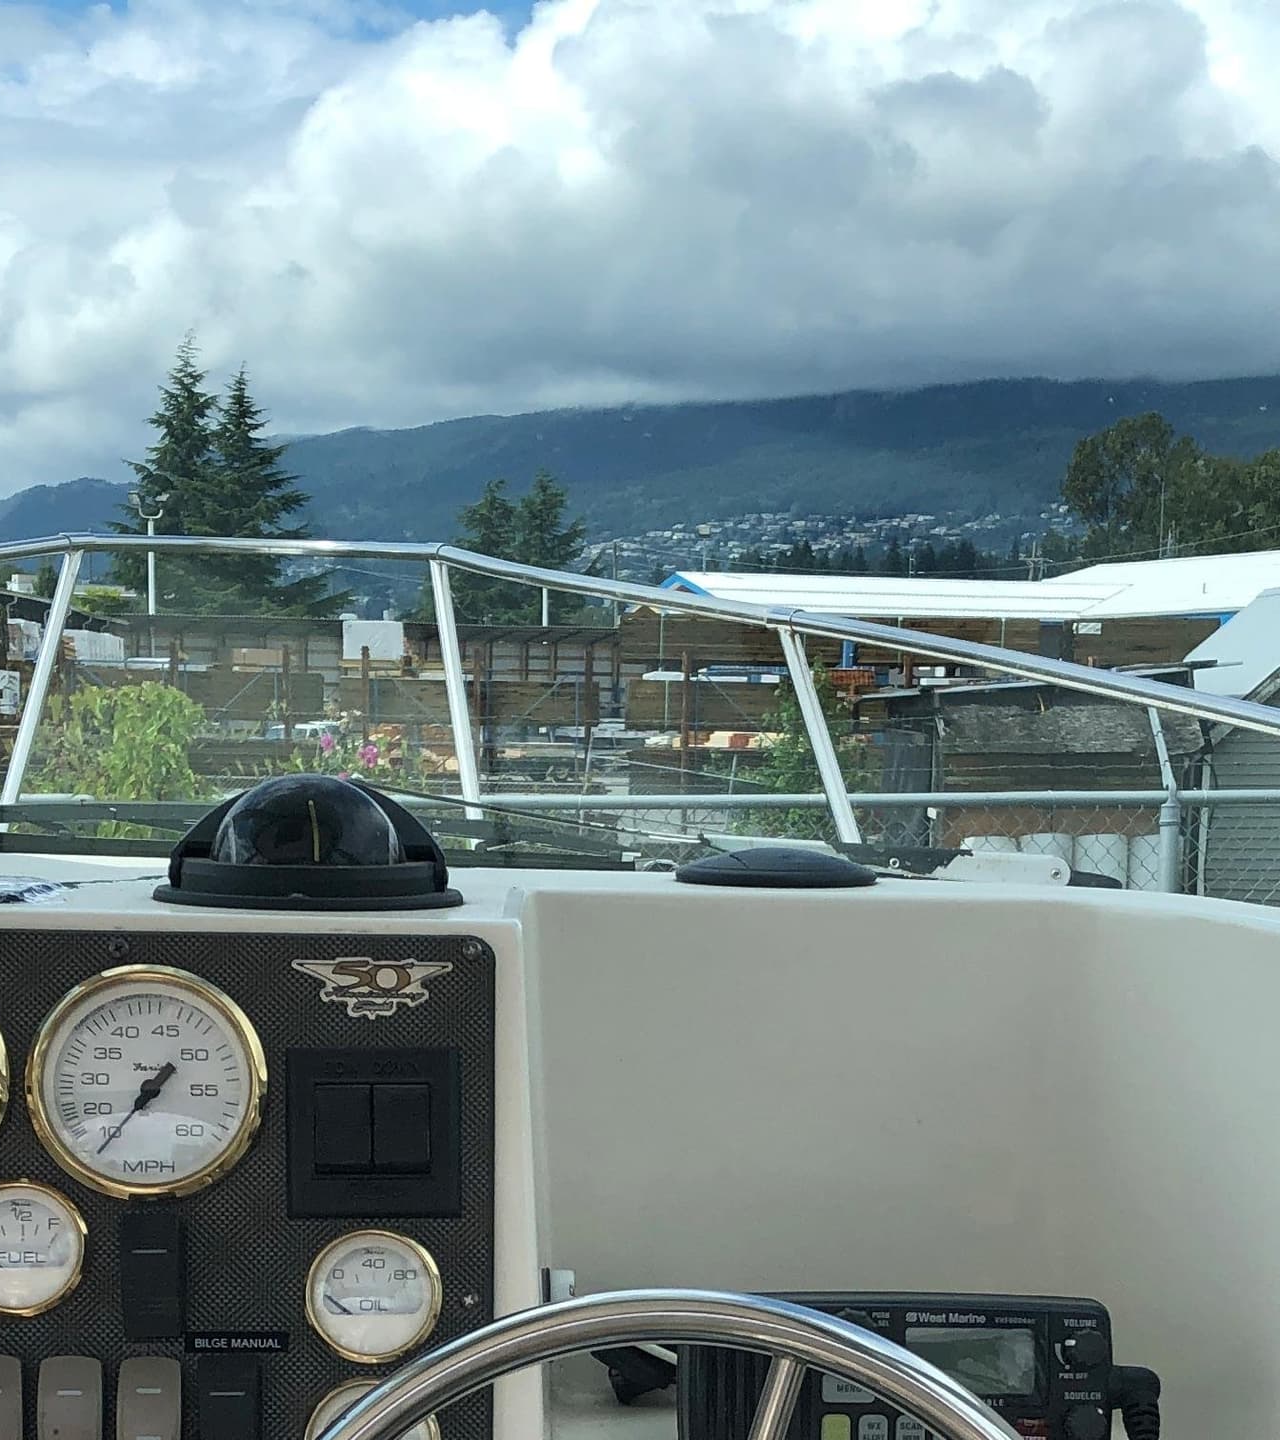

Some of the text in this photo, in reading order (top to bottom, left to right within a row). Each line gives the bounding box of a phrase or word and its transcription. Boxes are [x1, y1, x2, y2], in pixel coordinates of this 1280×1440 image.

[111, 1026, 140, 1039] 40
[151, 1025, 180, 1038] 45
[94, 1047, 122, 1060] 35
[180, 1049, 209, 1061] 50
[81, 1073, 110, 1086] 30
[190, 1084, 218, 1097] 55
[83, 1103, 112, 1115] 20
[100, 1126, 122, 1139] 10
[176, 1124, 204, 1137] 60
[123, 1160, 176, 1174] MPH
[49, 1218, 61, 1231] F
[362, 1259, 386, 1270] 40
[332, 1269, 345, 1280] 0
[360, 1299, 387, 1312] OIL
[919, 1312, 947, 1323] West
[949, 1313, 986, 1323] Marine
[1064, 1319, 1097, 1327] VOLUME
[195, 1337, 281, 1349] BILGE MANUAL
